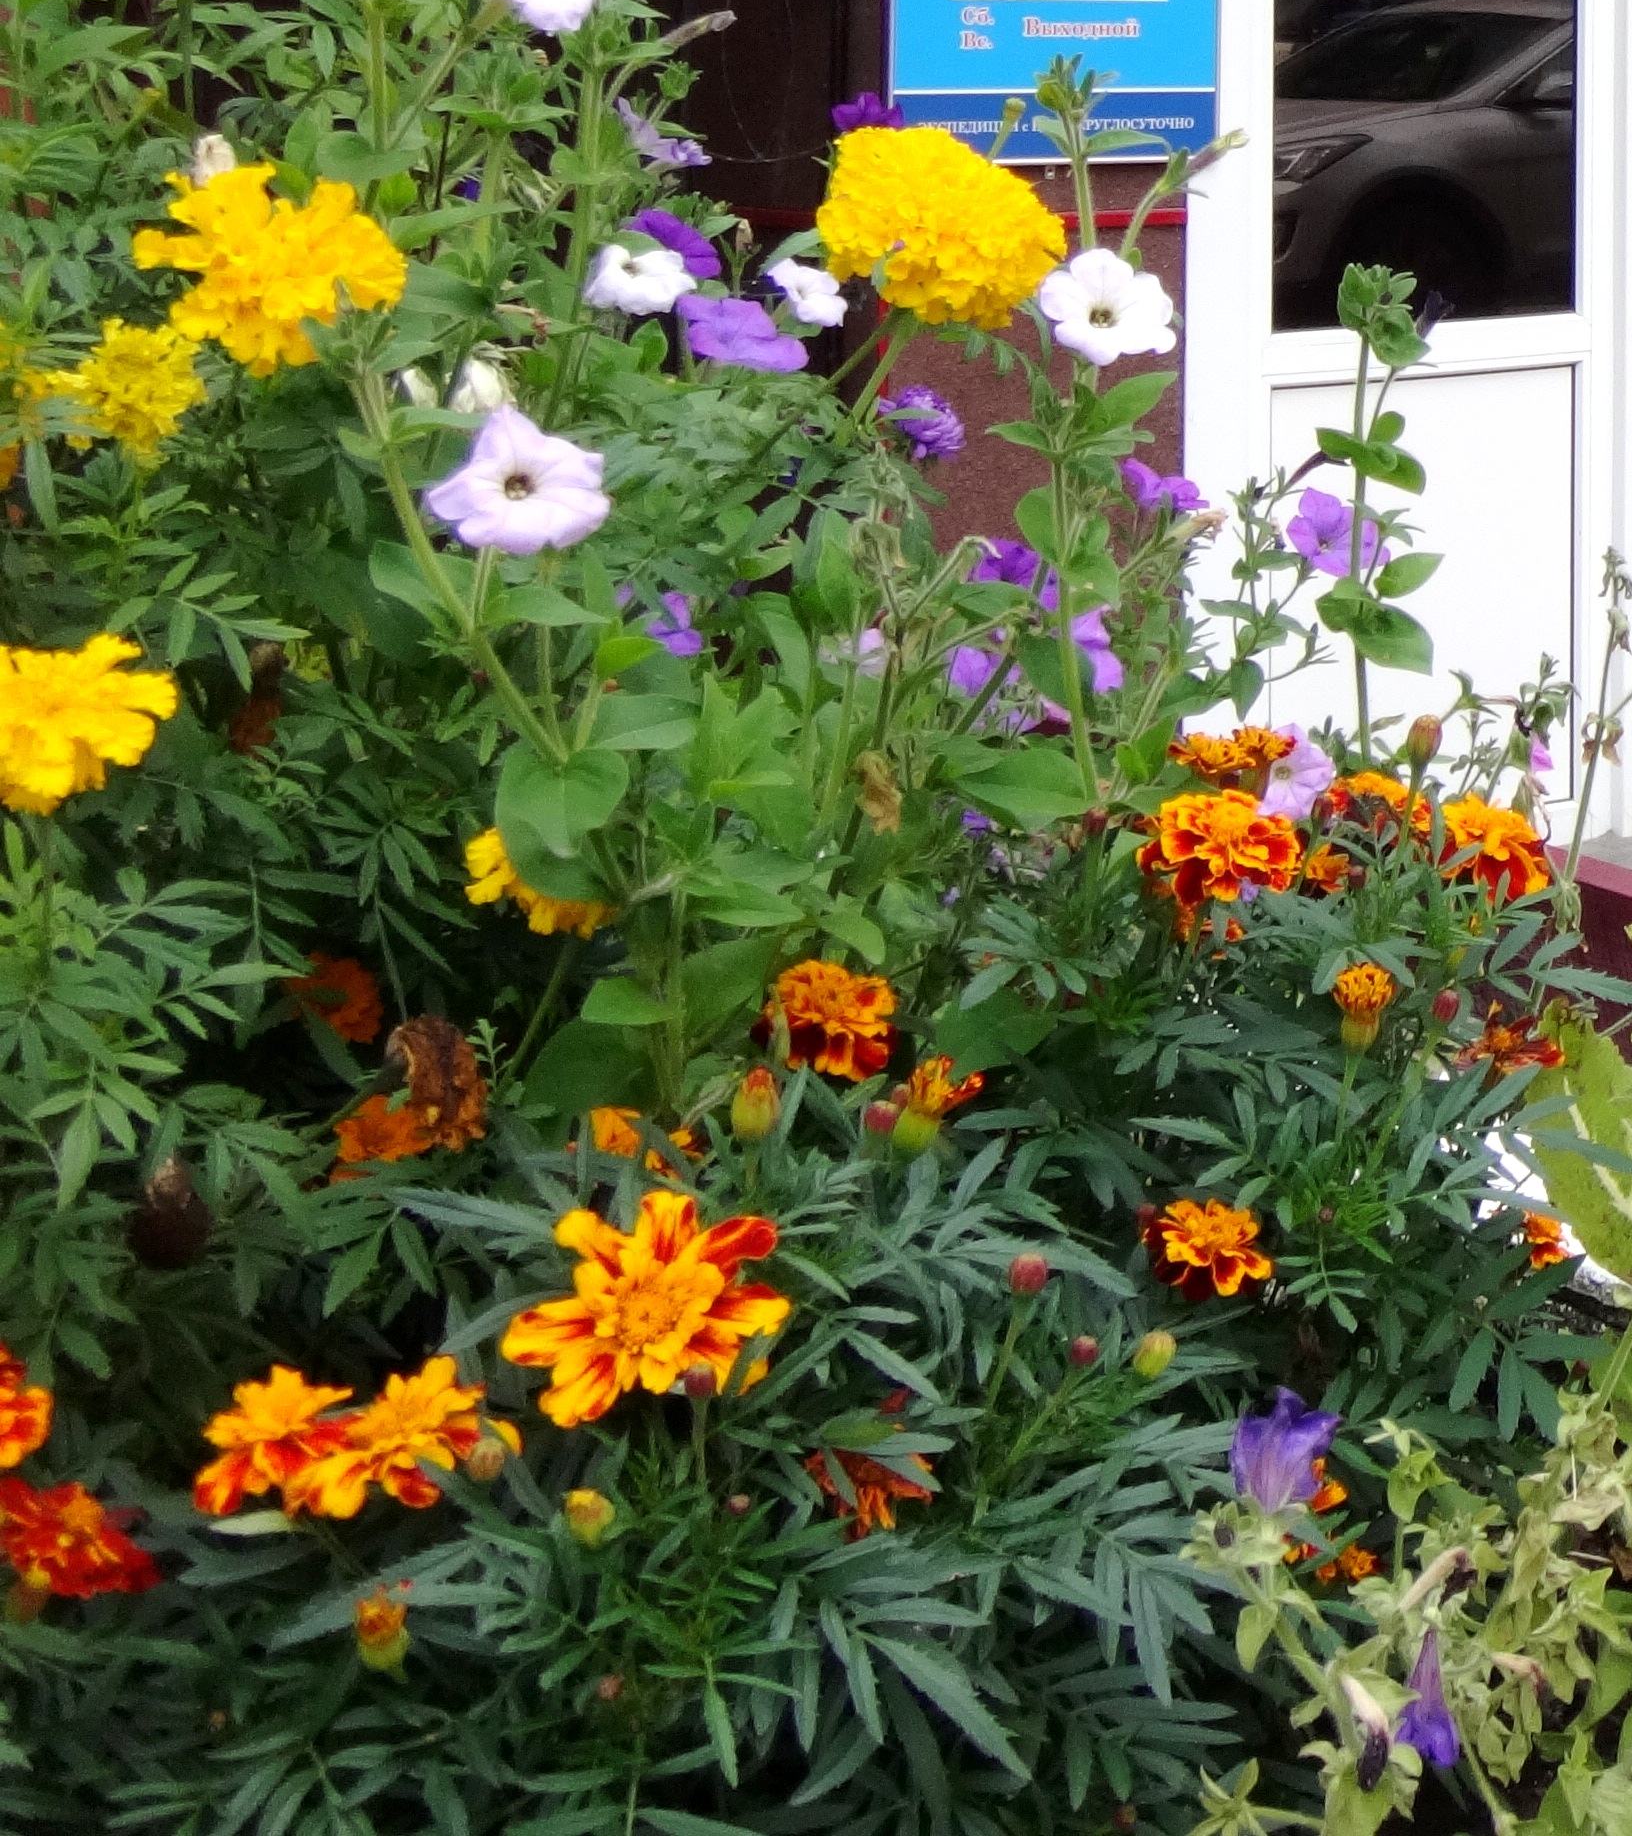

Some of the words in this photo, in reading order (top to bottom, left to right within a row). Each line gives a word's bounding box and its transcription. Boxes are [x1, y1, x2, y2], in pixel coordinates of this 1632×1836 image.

[961, 7, 995, 25] Сб.
[1022, 16, 1140, 39] Выходной
[960, 31, 994, 49] Вс.
[1081, 117, 1195, 131] РУГЛОСУТОЧНО
